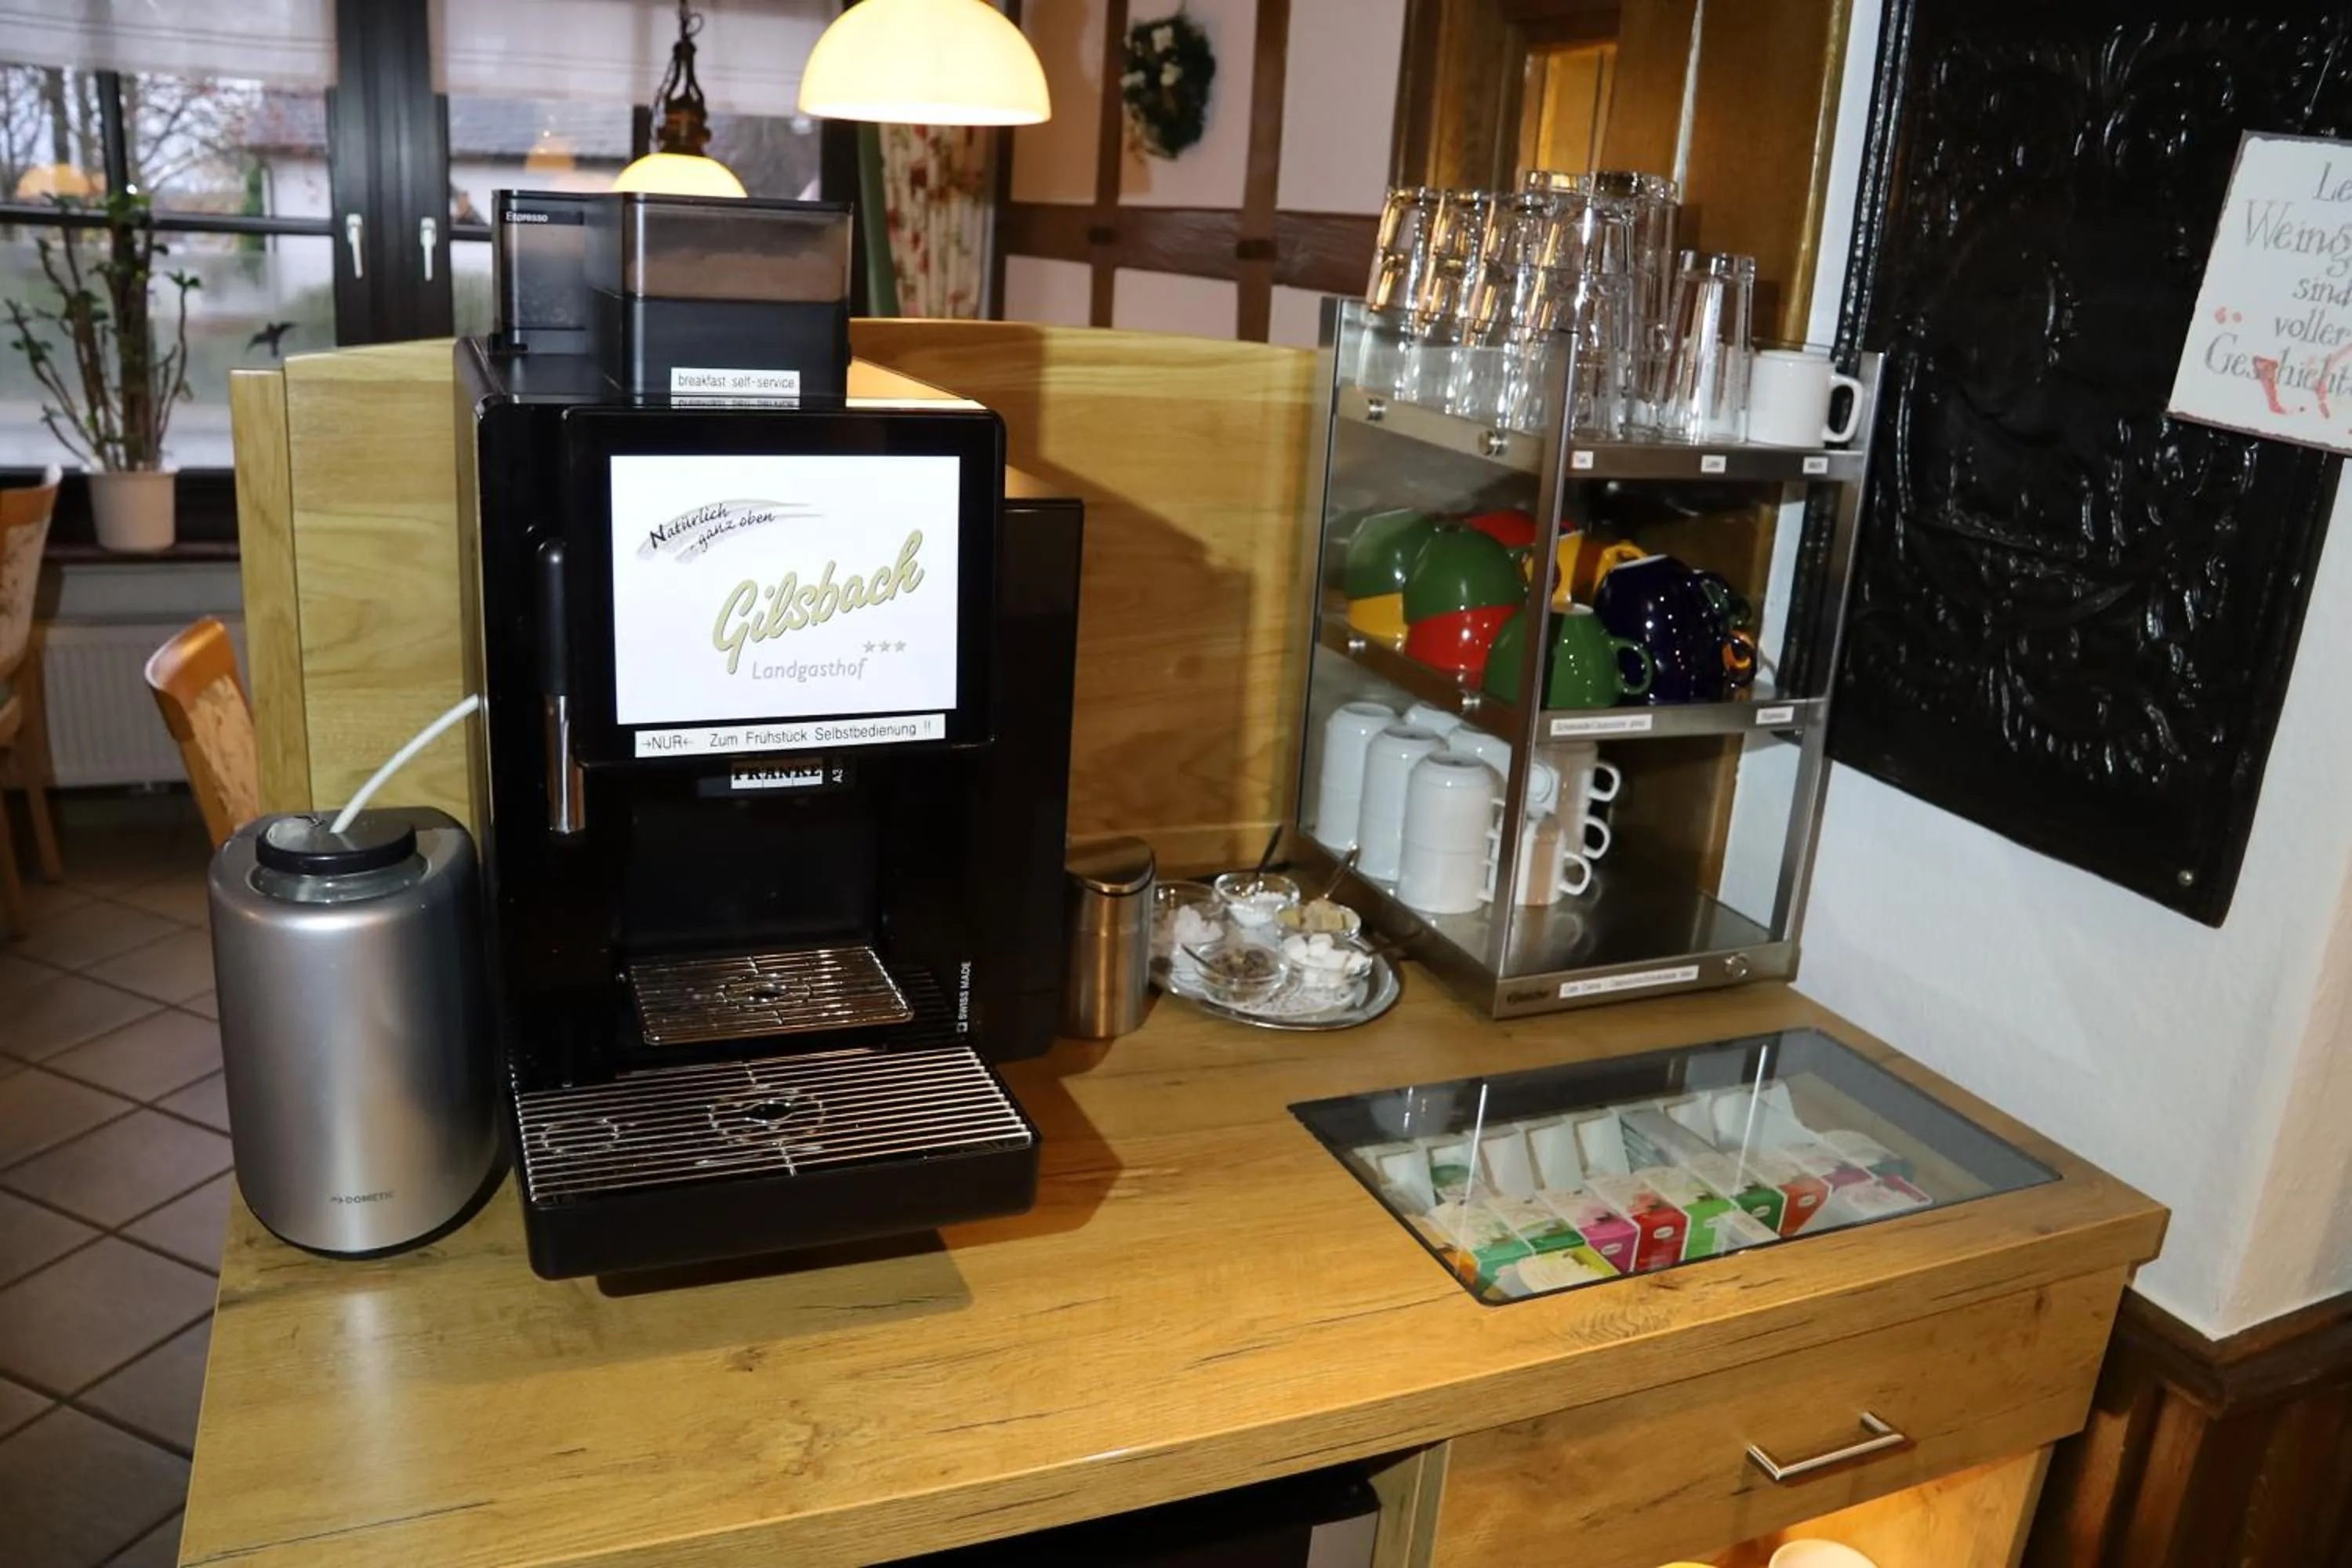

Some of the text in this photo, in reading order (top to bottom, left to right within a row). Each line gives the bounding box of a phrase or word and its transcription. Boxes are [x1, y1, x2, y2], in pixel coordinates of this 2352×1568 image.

[506, 211, 549, 222] Espresso
[2275, 309, 2351, 346] voller
[678, 374, 795, 389] breakfast self-service
[650, 502, 729, 549] Natürlich
[699, 510, 775, 553] ganz oben
[712, 529, 925, 675] Gilsbach
[752, 658, 868, 682] Landgasthof
[710, 733, 739, 747] Zum
[815, 724, 917, 742] Selbstbedienung
